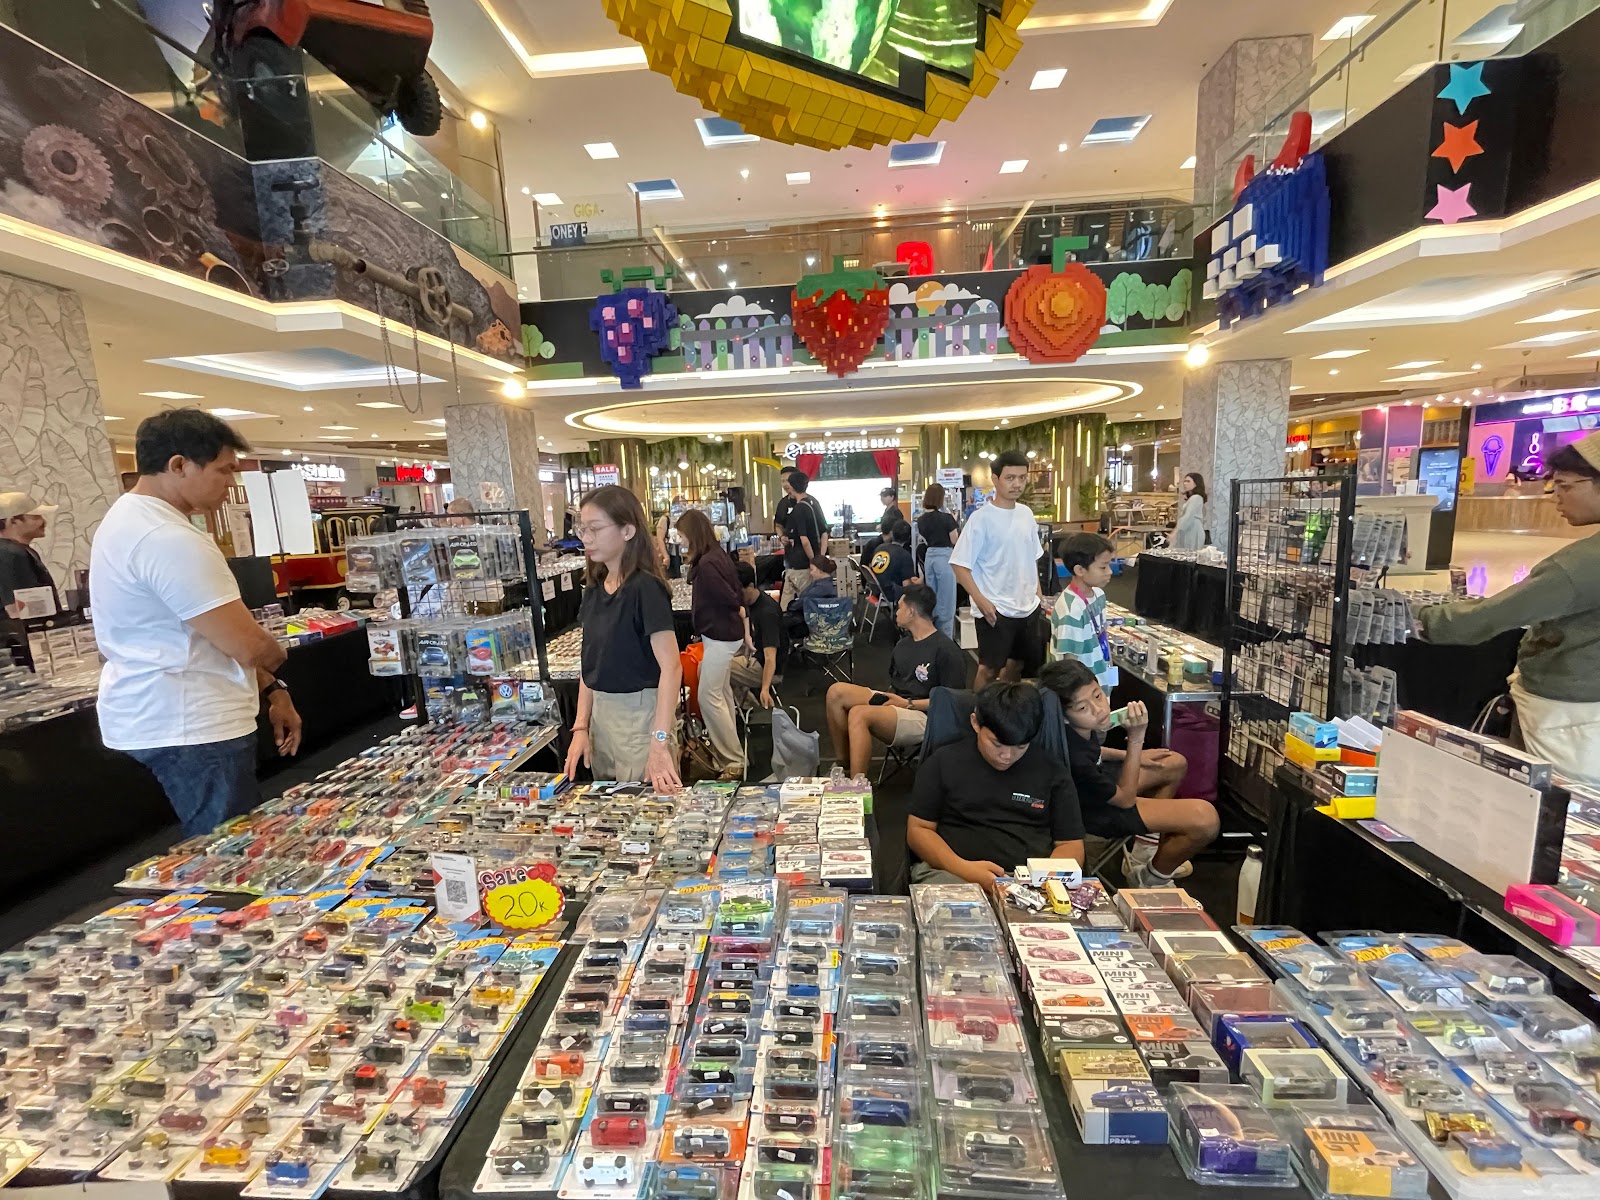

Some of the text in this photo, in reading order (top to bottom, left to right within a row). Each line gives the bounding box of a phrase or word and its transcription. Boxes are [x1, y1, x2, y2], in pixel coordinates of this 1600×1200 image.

[551, 224, 578, 240] ONEY
[804, 437, 901, 451] THE COFFEE BEAN
[595, 465, 615, 473] SALE
[1142, 1042, 1179, 1050] MINI
[1311, 1131, 1359, 1142] MINI
[1323, 1142, 1360, 1152] GT
